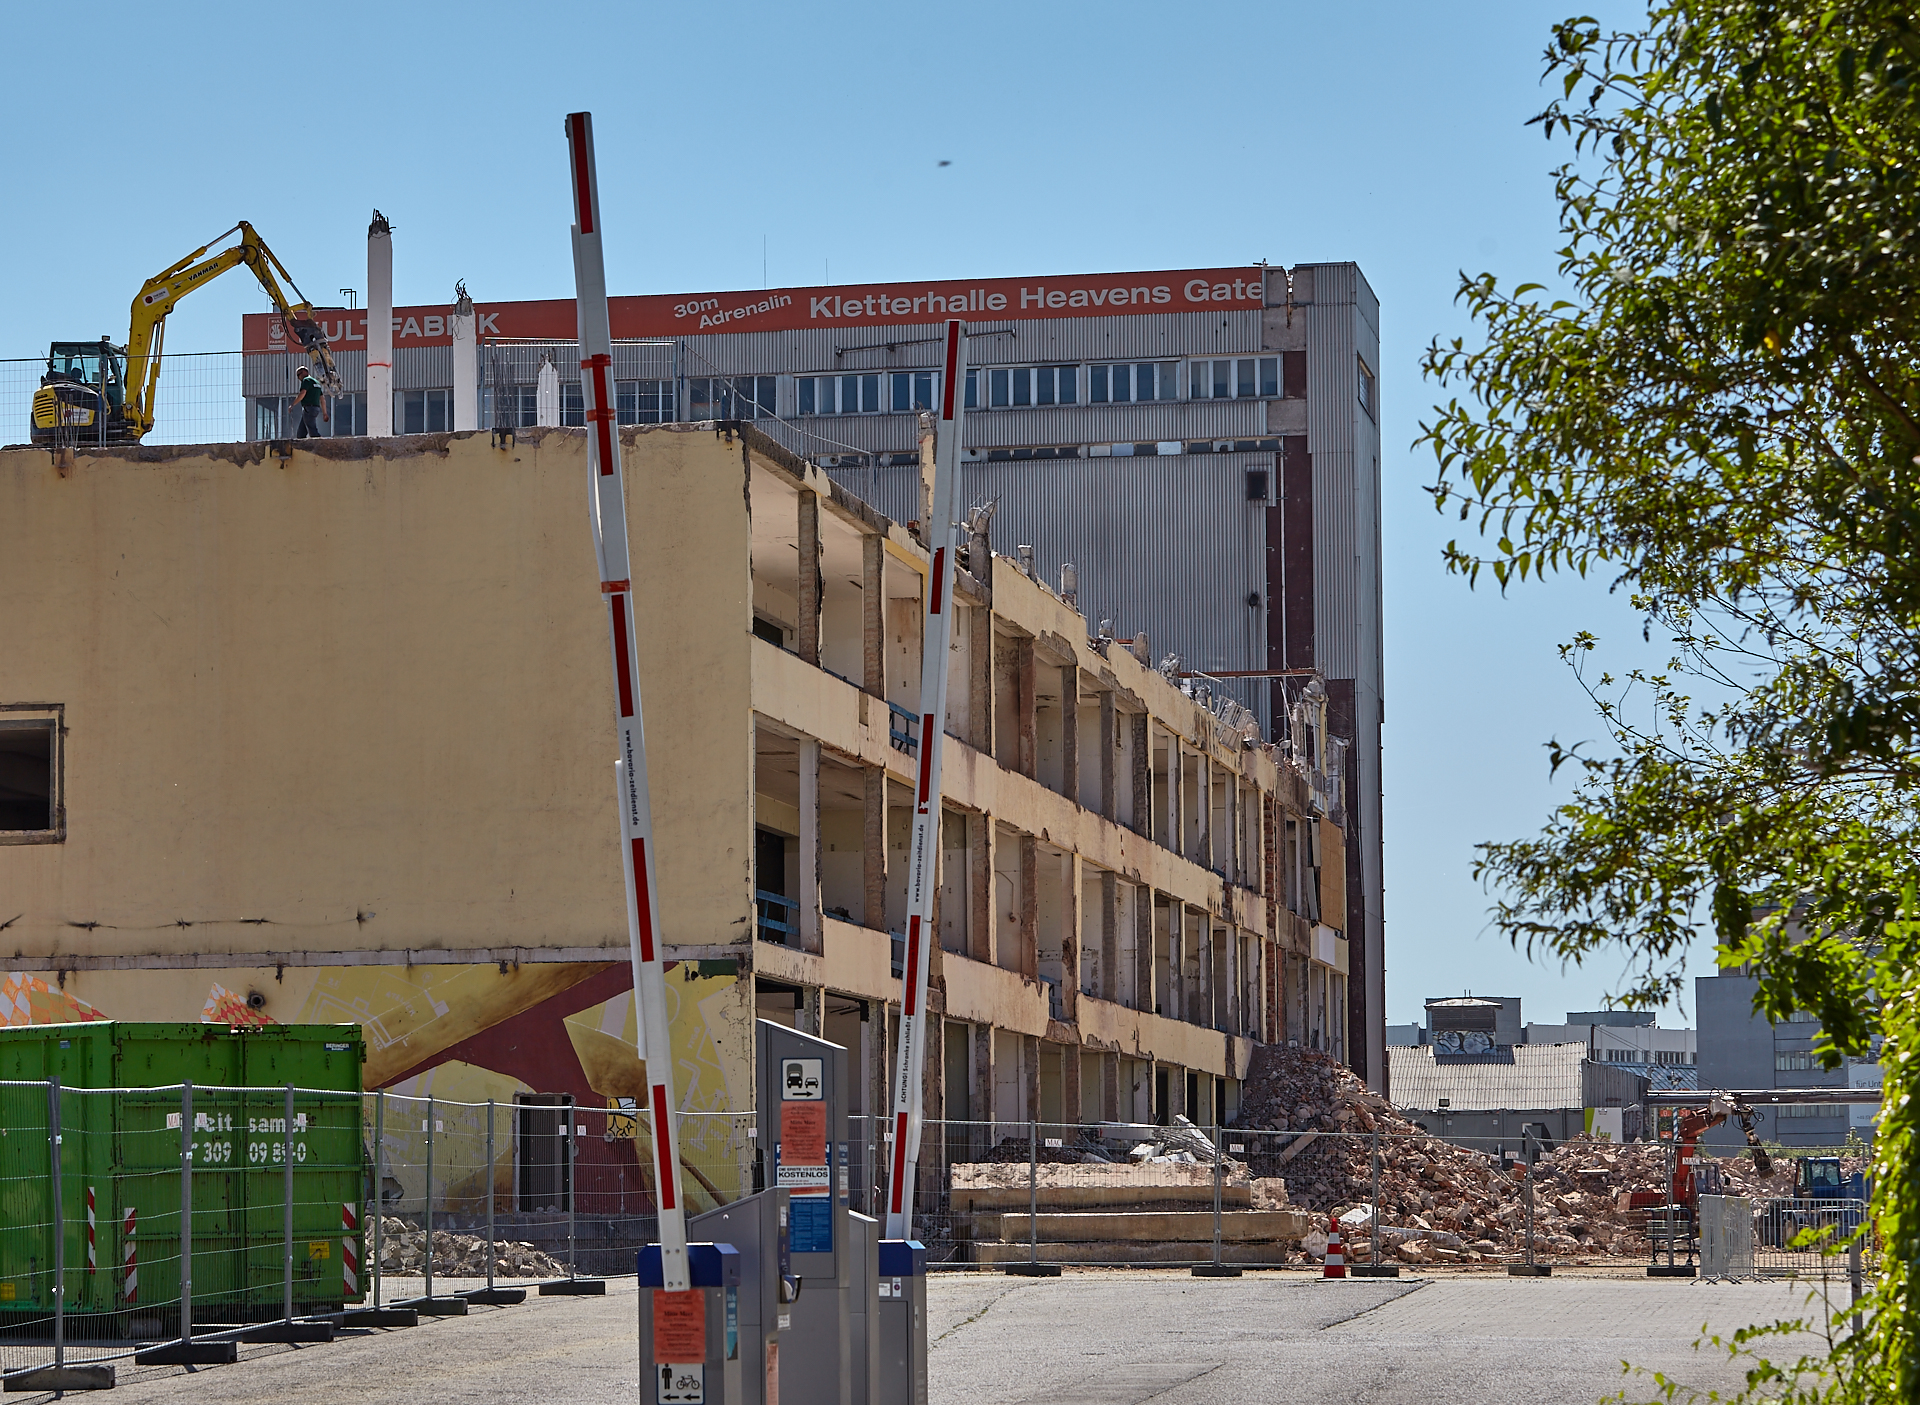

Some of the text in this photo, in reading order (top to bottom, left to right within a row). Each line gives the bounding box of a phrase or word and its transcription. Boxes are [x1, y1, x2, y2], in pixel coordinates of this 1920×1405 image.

[187, 262, 219, 281] YANMAR
[673, 297, 719, 318] 30m
[699, 294, 792, 329] Adrenalin
[810, 278, 1262, 318] Kletterhalle Heavens Gate
[625, 729, 640, 826] www.bavaria-zeitdienst.de
[914, 824, 924, 903] www.bavaria-zeitdienst.de
[902, 1045, 910, 1072] Schranke
[900, 1072, 908, 1103] ACHTUNG!
[1855, 1080, 1882, 1088] für Unt
[203, 1141, 232, 1163] 309
[249, 1141, 268, 1163] 09
